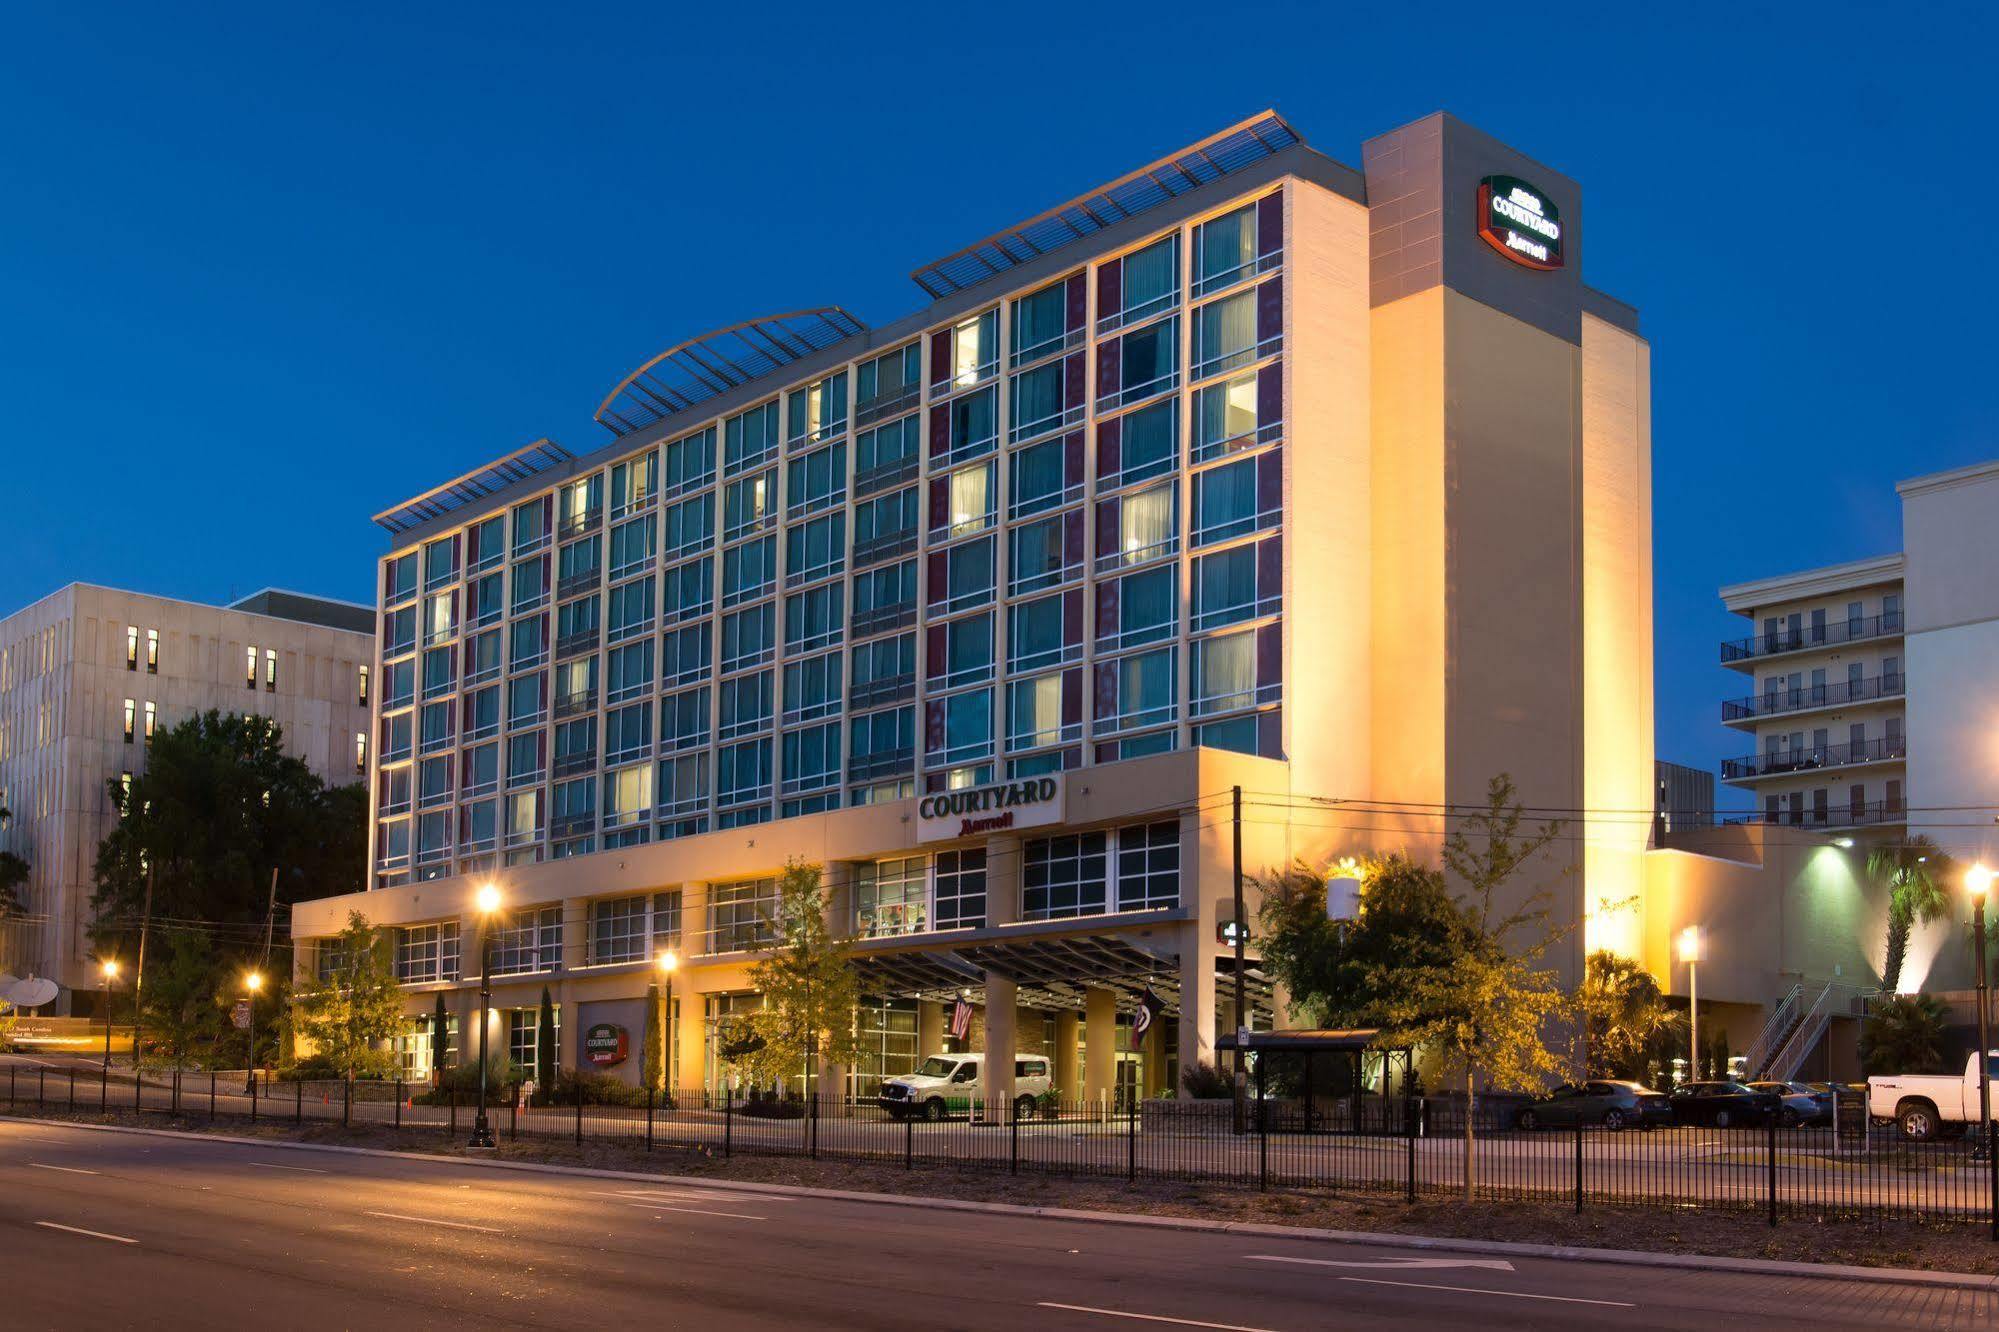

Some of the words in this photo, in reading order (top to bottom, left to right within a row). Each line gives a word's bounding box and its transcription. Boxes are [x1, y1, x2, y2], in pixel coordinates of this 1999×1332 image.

[1492, 195, 1559, 240] COURTYARD
[919, 777, 1057, 820] COURTYARD
[958, 811, 1014, 837] Marriott
